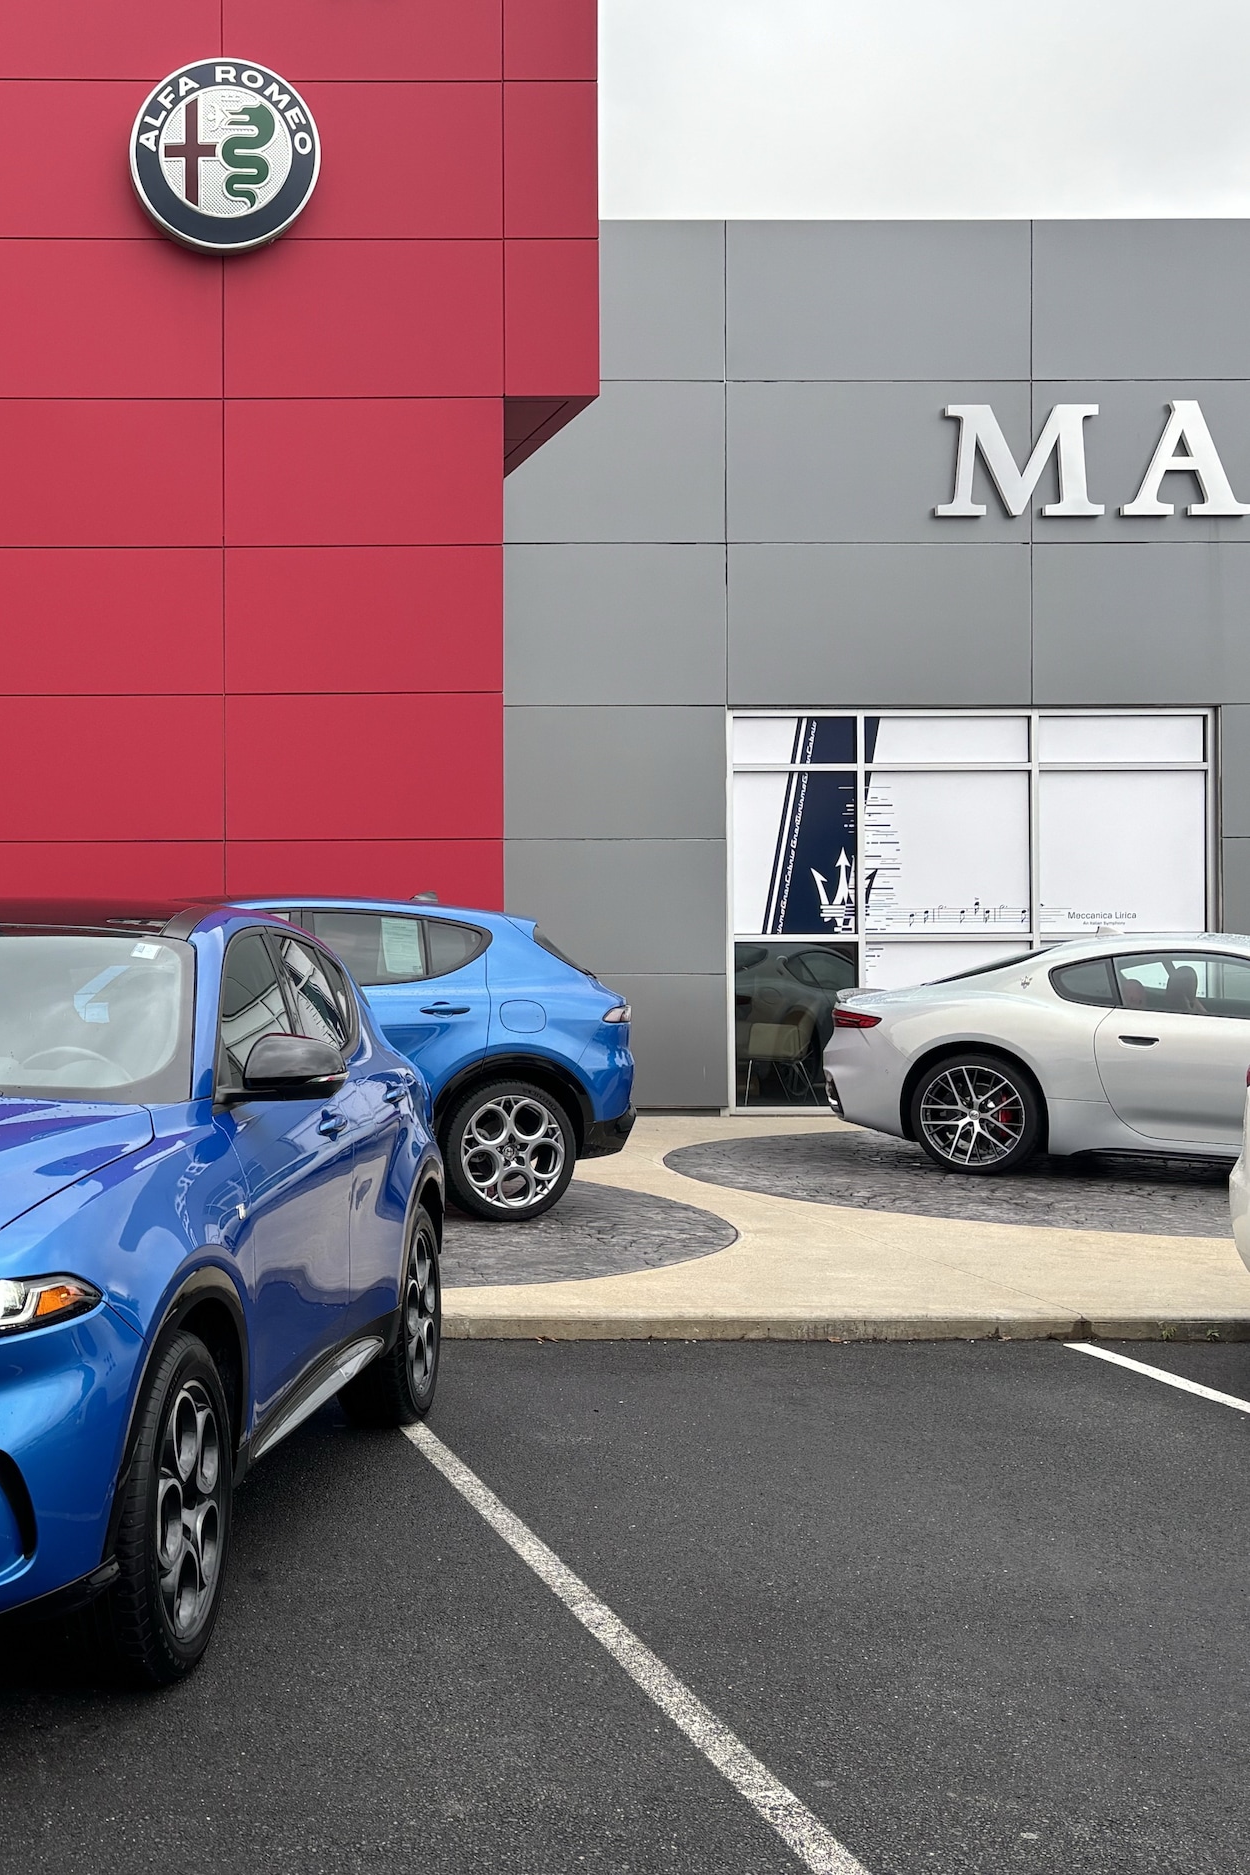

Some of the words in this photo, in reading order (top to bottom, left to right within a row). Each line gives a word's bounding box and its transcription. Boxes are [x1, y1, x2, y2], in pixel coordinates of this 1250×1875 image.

[138, 75, 200, 153] ALFA
[214, 65, 313, 155] ROMEO
[934, 399, 1250, 518] MA
